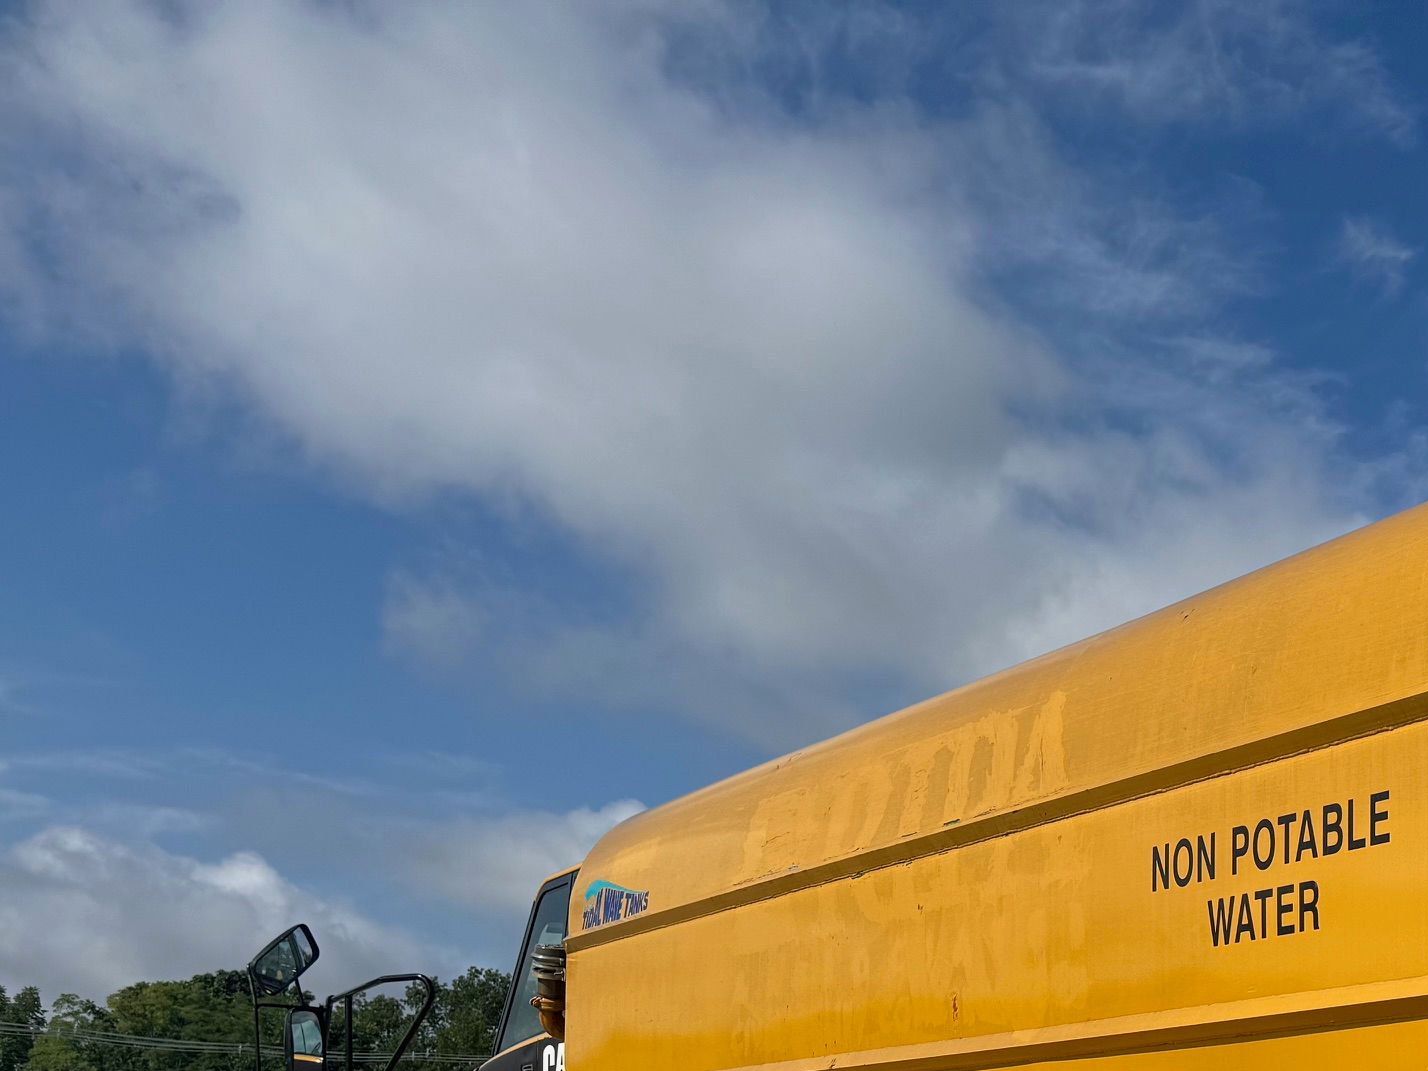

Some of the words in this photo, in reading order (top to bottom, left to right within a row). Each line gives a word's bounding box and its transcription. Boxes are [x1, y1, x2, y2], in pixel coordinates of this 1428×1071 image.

[1151, 831, 1216, 892] NON
[1231, 790, 1391, 876] POTABLE
[602, 888, 624, 925] WAVE
[624, 890, 650, 919] TANKS
[1207, 880, 1320, 947] WATER
